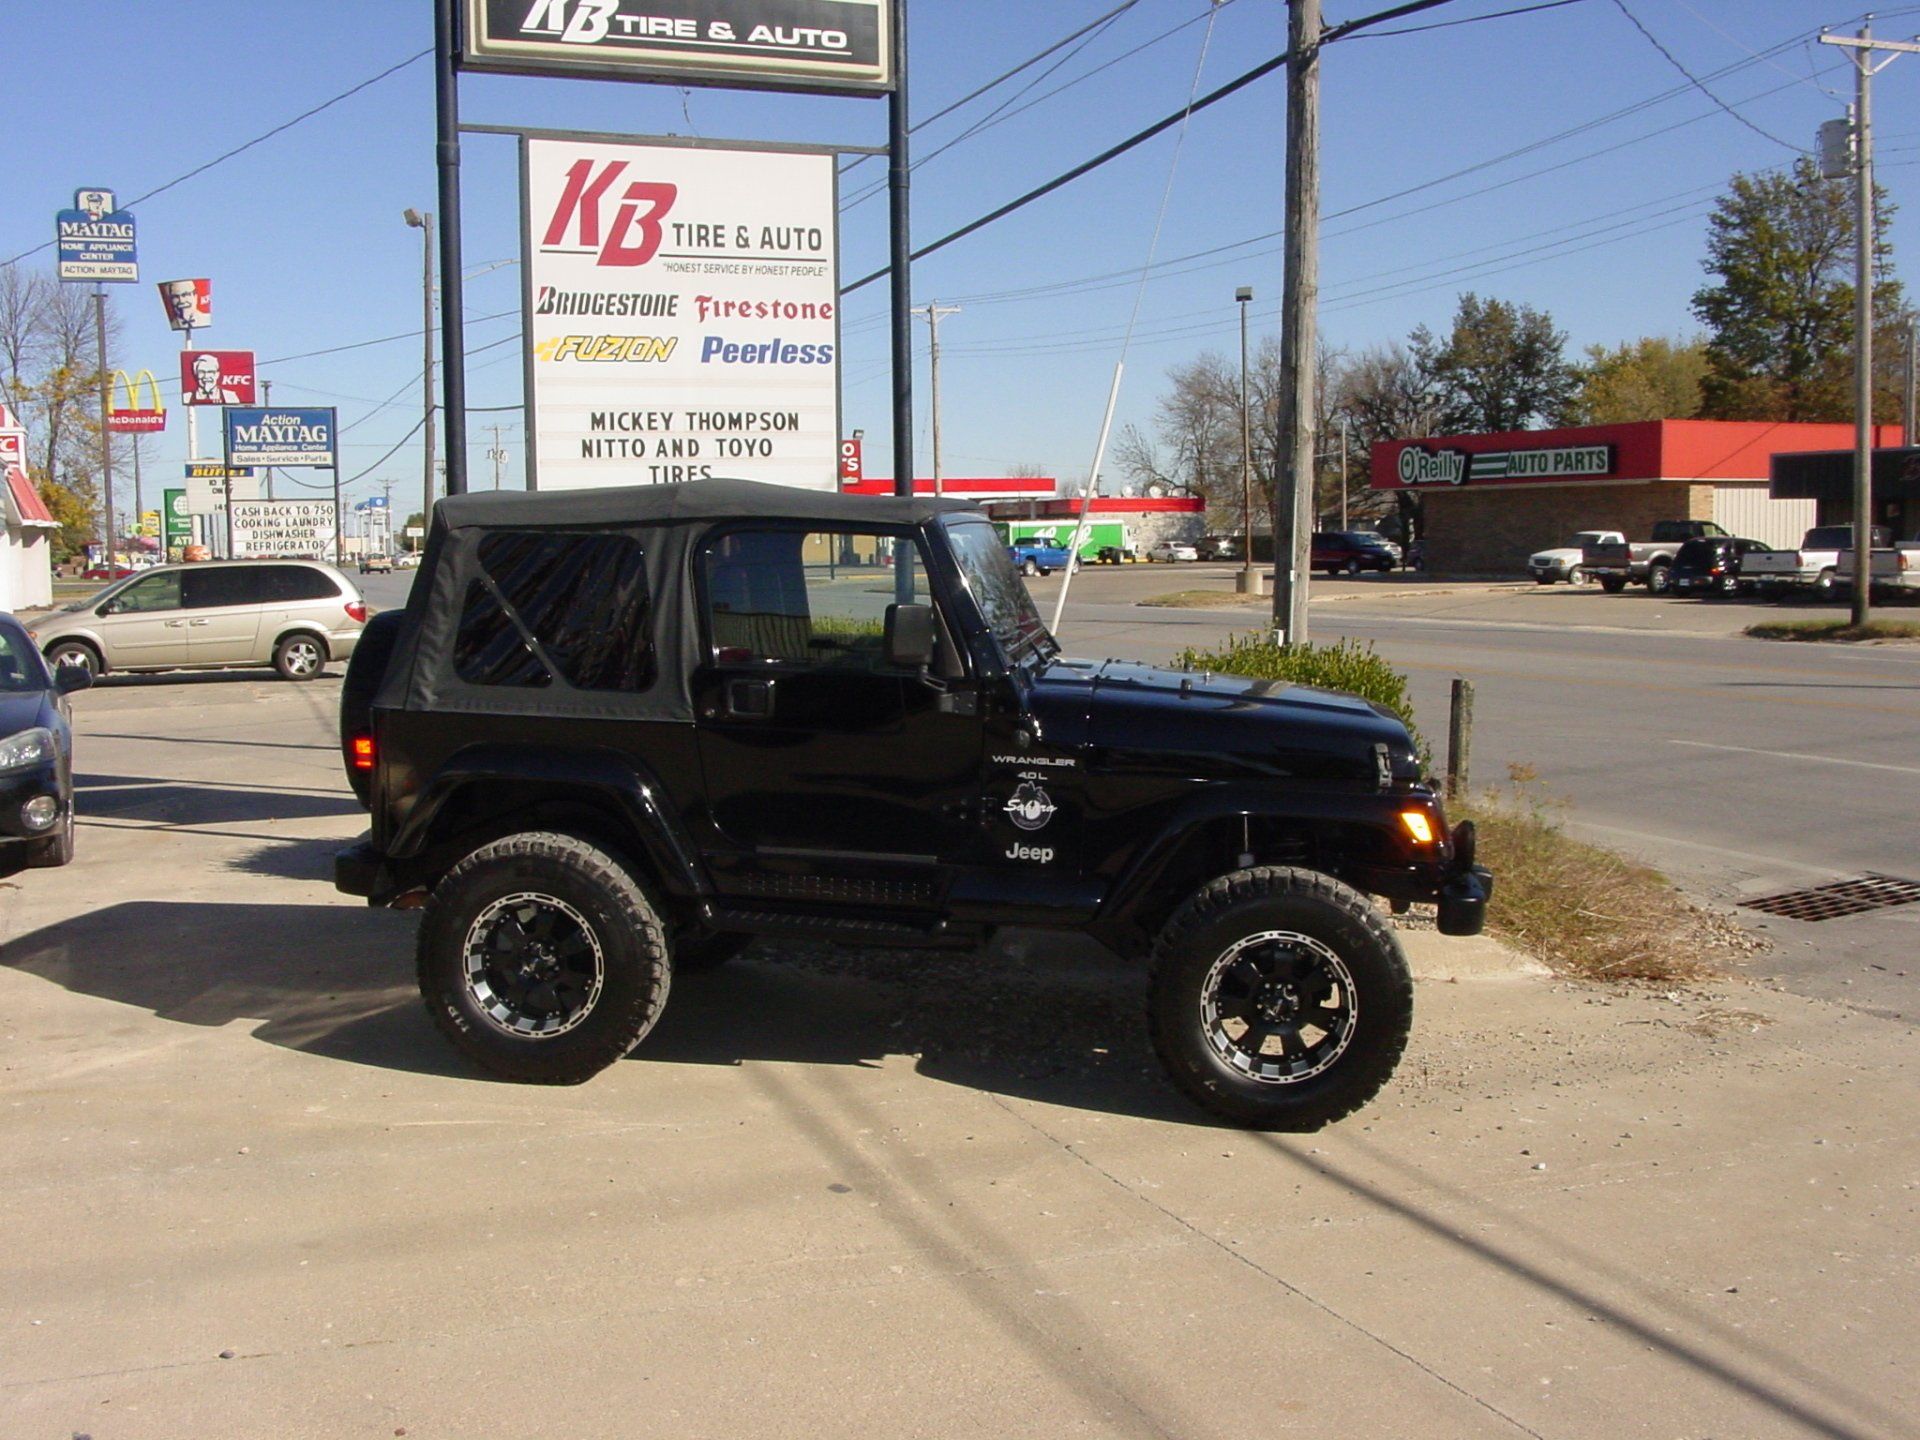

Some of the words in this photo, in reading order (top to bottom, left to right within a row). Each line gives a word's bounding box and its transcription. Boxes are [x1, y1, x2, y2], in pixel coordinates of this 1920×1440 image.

[615, 14, 698, 38] TIRE
[707, 22, 736, 41] &
[747, 24, 848, 49] AUTO
[541, 158, 678, 267] KB
[672, 223, 726, 248] TIRE
[735, 225, 750, 249] &
[759, 226, 823, 251] AUTO
[60, 221, 134, 237] MAYTAG
[60, 242, 86, 251] HOME
[89, 243, 134, 252] APPLIANCE
[80, 252, 114, 261] CENTER
[64, 265, 96, 274] ACTION
[99, 266, 133, 275] MAYTAG
[703, 263, 739, 274] SERVICE
[741, 265, 753, 274] BY
[754, 265, 789, 276] HONEST
[535, 286, 680, 317] BRIDGESTONE
[694, 294, 833, 323] Firestone
[553, 334, 679, 363] FUZION
[700, 336, 834, 364] Peerless
[221, 375, 252, 385] KFC
[260, 414, 302, 426] Action
[590, 411, 673, 432] MICKEY
[685, 412, 800, 432] THOMPSON
[234, 425, 328, 443] MAYTAG
[235, 444, 258, 452] Home
[260, 444, 298, 453] Appliance
[301, 443, 328, 452] Center
[581, 438, 646, 458] NITTO
[655, 438, 700, 458] AND
[715, 438, 773, 458] TOYO
[1400, 447, 1465, 484] O'Reilly
[1508, 453, 1549, 475] AUTO
[1553, 449, 1607, 473] PARTS
[648, 465, 712, 484] TIRES
[234, 506, 261, 517] CASH
[263, 507, 292, 517] BACK
[296, 506, 310, 515] TO
[314, 505, 334, 515] 750
[234, 518, 281, 529] COOKING
[285, 518, 333, 527] LAUNDRY
[252, 529, 316, 540] DISHWASHER
[245, 540, 325, 552] REFRIGERATOR
[991, 755, 1076, 767] WRANGLER
[1005, 842, 1054, 864] Jeep
